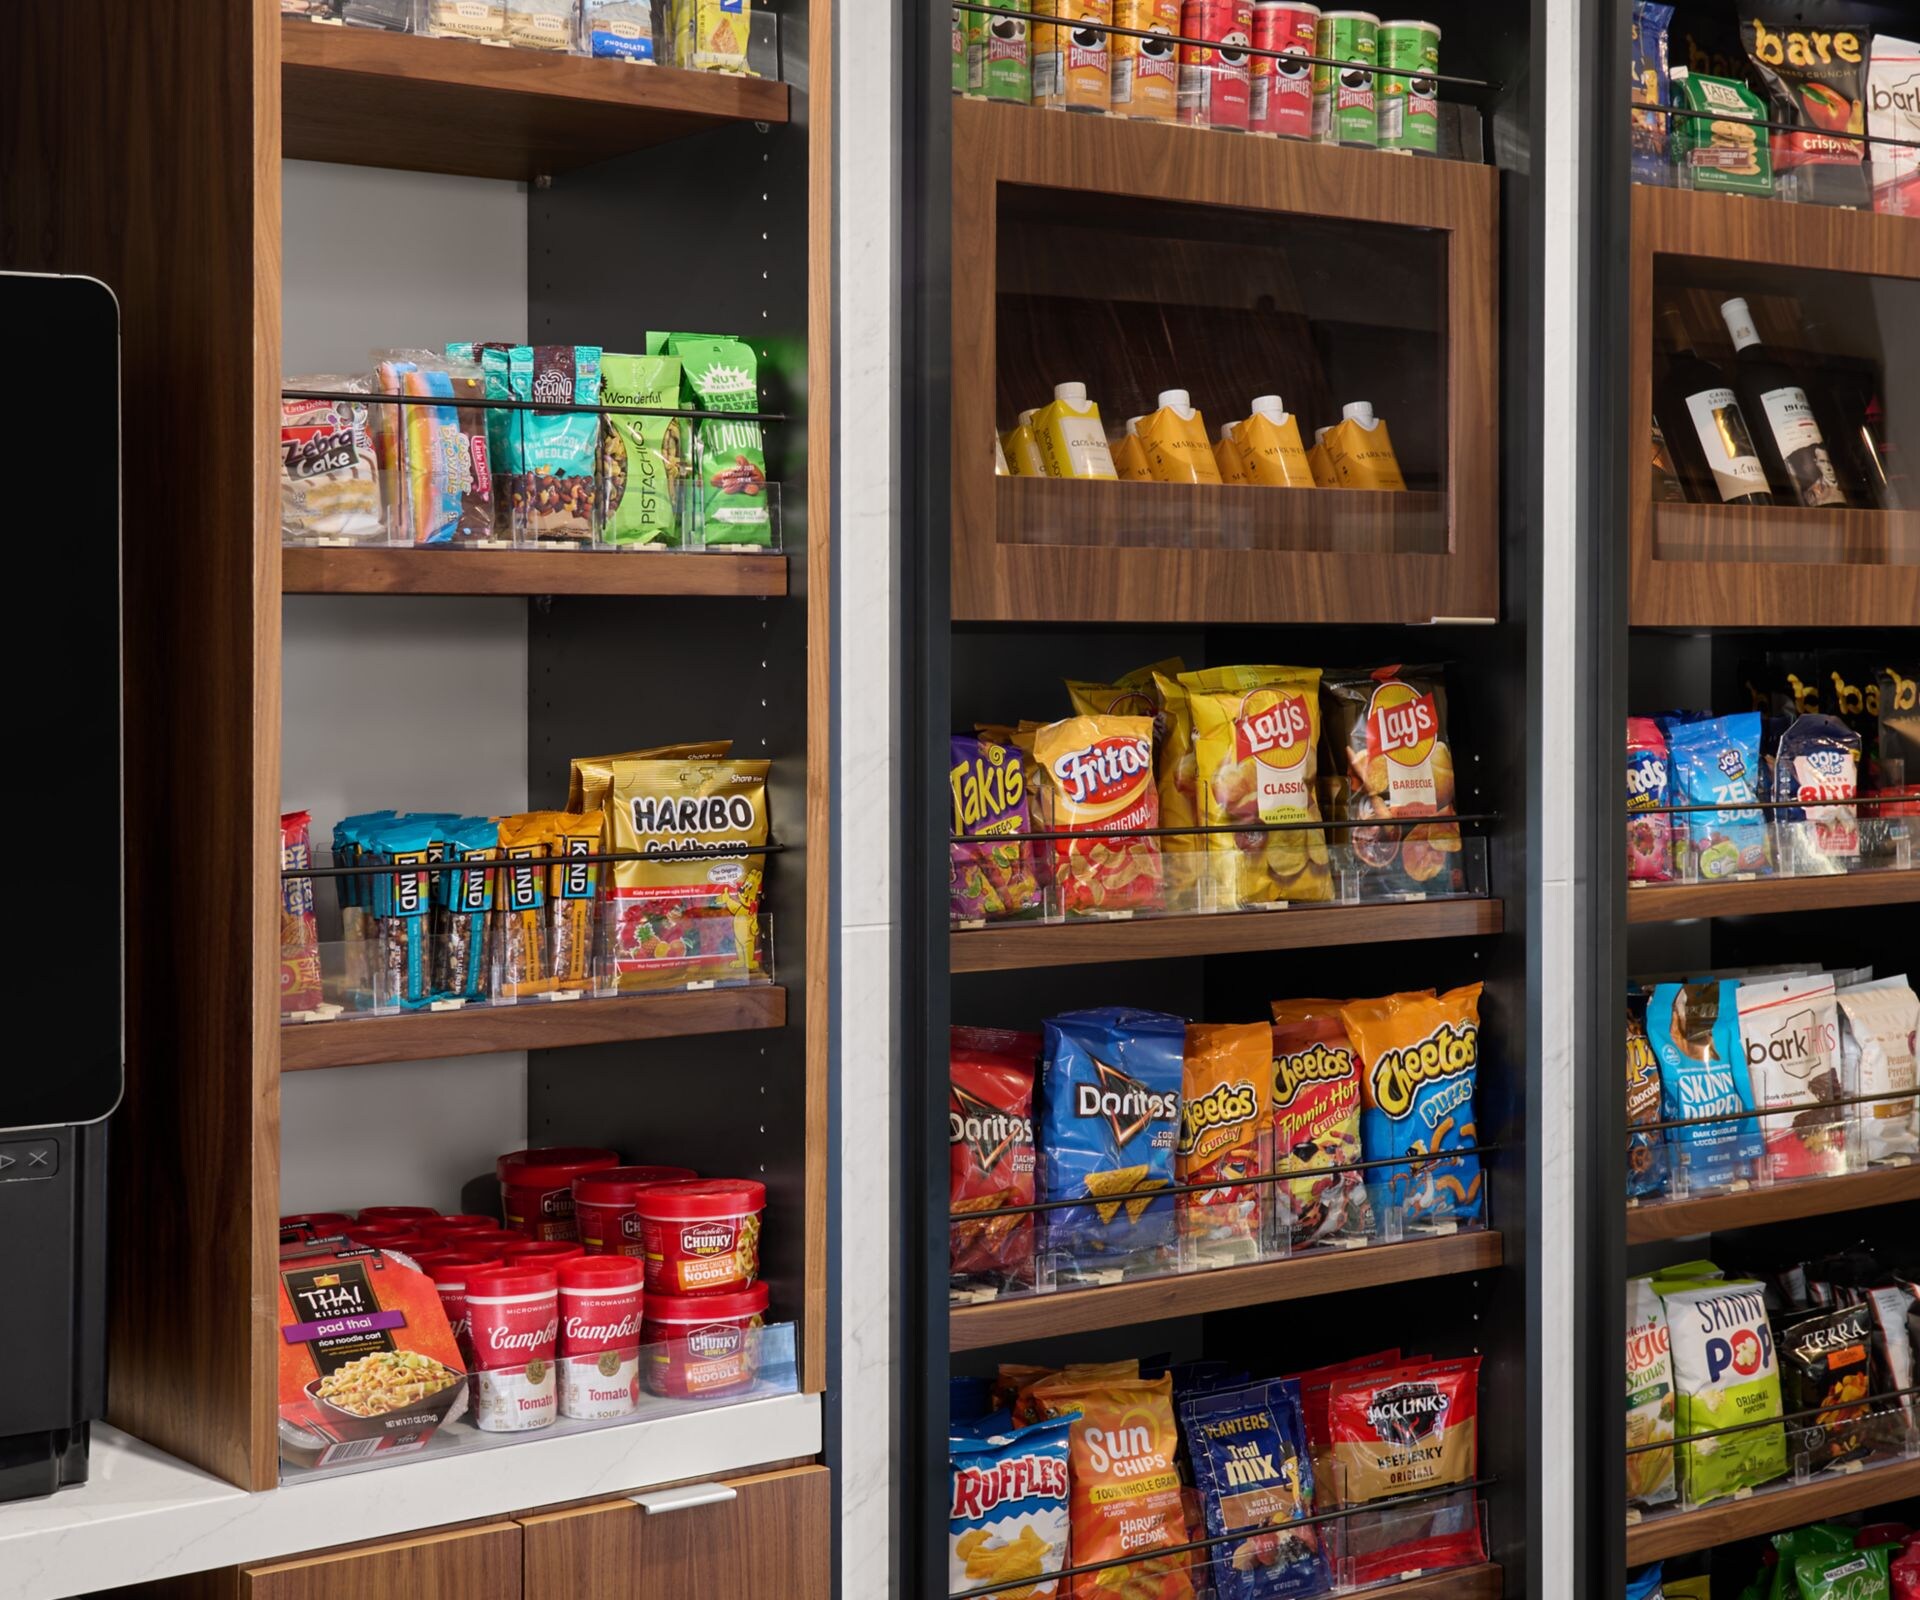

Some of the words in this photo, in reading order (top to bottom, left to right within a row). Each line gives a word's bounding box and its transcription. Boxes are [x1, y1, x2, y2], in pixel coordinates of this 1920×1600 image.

[990, 39, 1027, 64] PRINGLES
[1753, 18, 1862, 67] bare
[1070, 46, 1107, 73] PRINGLES
[1139, 57, 1175, 81] PRINGLES
[1275, 76, 1311, 98] PRINGLES
[1807, 70, 1857, 80] CRUNCHY
[1339, 89, 1374, 112] PRINGLES
[1803, 135, 1841, 153] crispy
[534, 377, 573, 397] SECOND
[712, 374, 737, 384] NUT
[604, 390, 662, 405] Wonderful
[281, 429, 353, 466] Zebra
[440, 424, 458, 495] Brownie
[297, 451, 351, 478] Cake
[1242, 698, 1306, 753] Lay's
[1377, 697, 1432, 752] Lay's
[731, 774, 753, 784] Share
[1054, 738, 1151, 803] Fritos
[950, 757, 1024, 836] Takis
[1263, 781, 1306, 796] CLASSIC
[1392, 778, 1433, 791] BARBECUE
[632, 796, 754, 835] HARIBO
[1103, 803, 1151, 831] ORIGINAL
[570, 842, 588, 892] KND
[1272, 1044, 1353, 1107] Cheetos
[1372, 1022, 1478, 1119] Cheetos
[1078, 1084, 1179, 1119] Doritos
[1327, 1081, 1358, 1105] Hot
[950, 1112, 1034, 1145] Doritos
[1308, 1103, 1358, 1138] Crunchy
[1197, 1126, 1242, 1158] Crunchy
[1692, 1130, 1711, 1139] DARK
[684, 1234, 732, 1250] CHUNKY
[684, 1261, 709, 1274] CLASSIC
[685, 1267, 734, 1282] NOODLE
[298, 1285, 361, 1310] THAI
[580, 1296, 637, 1308] MICROWAVABLE
[315, 1305, 364, 1318] KITCHEN
[317, 1320, 345, 1336] pad
[345, 1317, 372, 1330] thai
[1801, 1319, 1869, 1352] TERRA
[318, 1338, 335, 1348] rice
[335, 1334, 364, 1345] noodle
[364, 1331, 381, 1341] cart
[690, 1335, 739, 1352] CHUNKY
[1705, 1323, 1772, 1384] POP
[693, 1366, 740, 1384] NOODLE
[588, 1387, 629, 1402] Tomato
[1632, 1394, 1649, 1406] Sea
[1735, 1389, 1770, 1408] ORIGINAL
[597, 1409, 621, 1419] SOUP
[1367, 1401, 1402, 1425] JACK
[1743, 1401, 1767, 1415] POPCORN
[1203, 1411, 1270, 1440] PLANTERS
[1085, 1424, 1152, 1474] Sun
[1227, 1440, 1261, 1460] Trail
[1377, 1452, 1407, 1469] BEEF
[1406, 1446, 1444, 1466] JERKY
[1112, 1453, 1168, 1478] CHIPS
[1225, 1453, 1281, 1487] mix
[1390, 1465, 1434, 1484] ORIGINAL
[950, 1454, 1068, 1521] RUFFLES
[1121, 1479, 1155, 1496] WHOLE
[1247, 1502, 1283, 1518] CHOCOLATE
[1120, 1513, 1167, 1537] HARVEST
[1121, 1526, 1169, 1551] CHEDDAR
